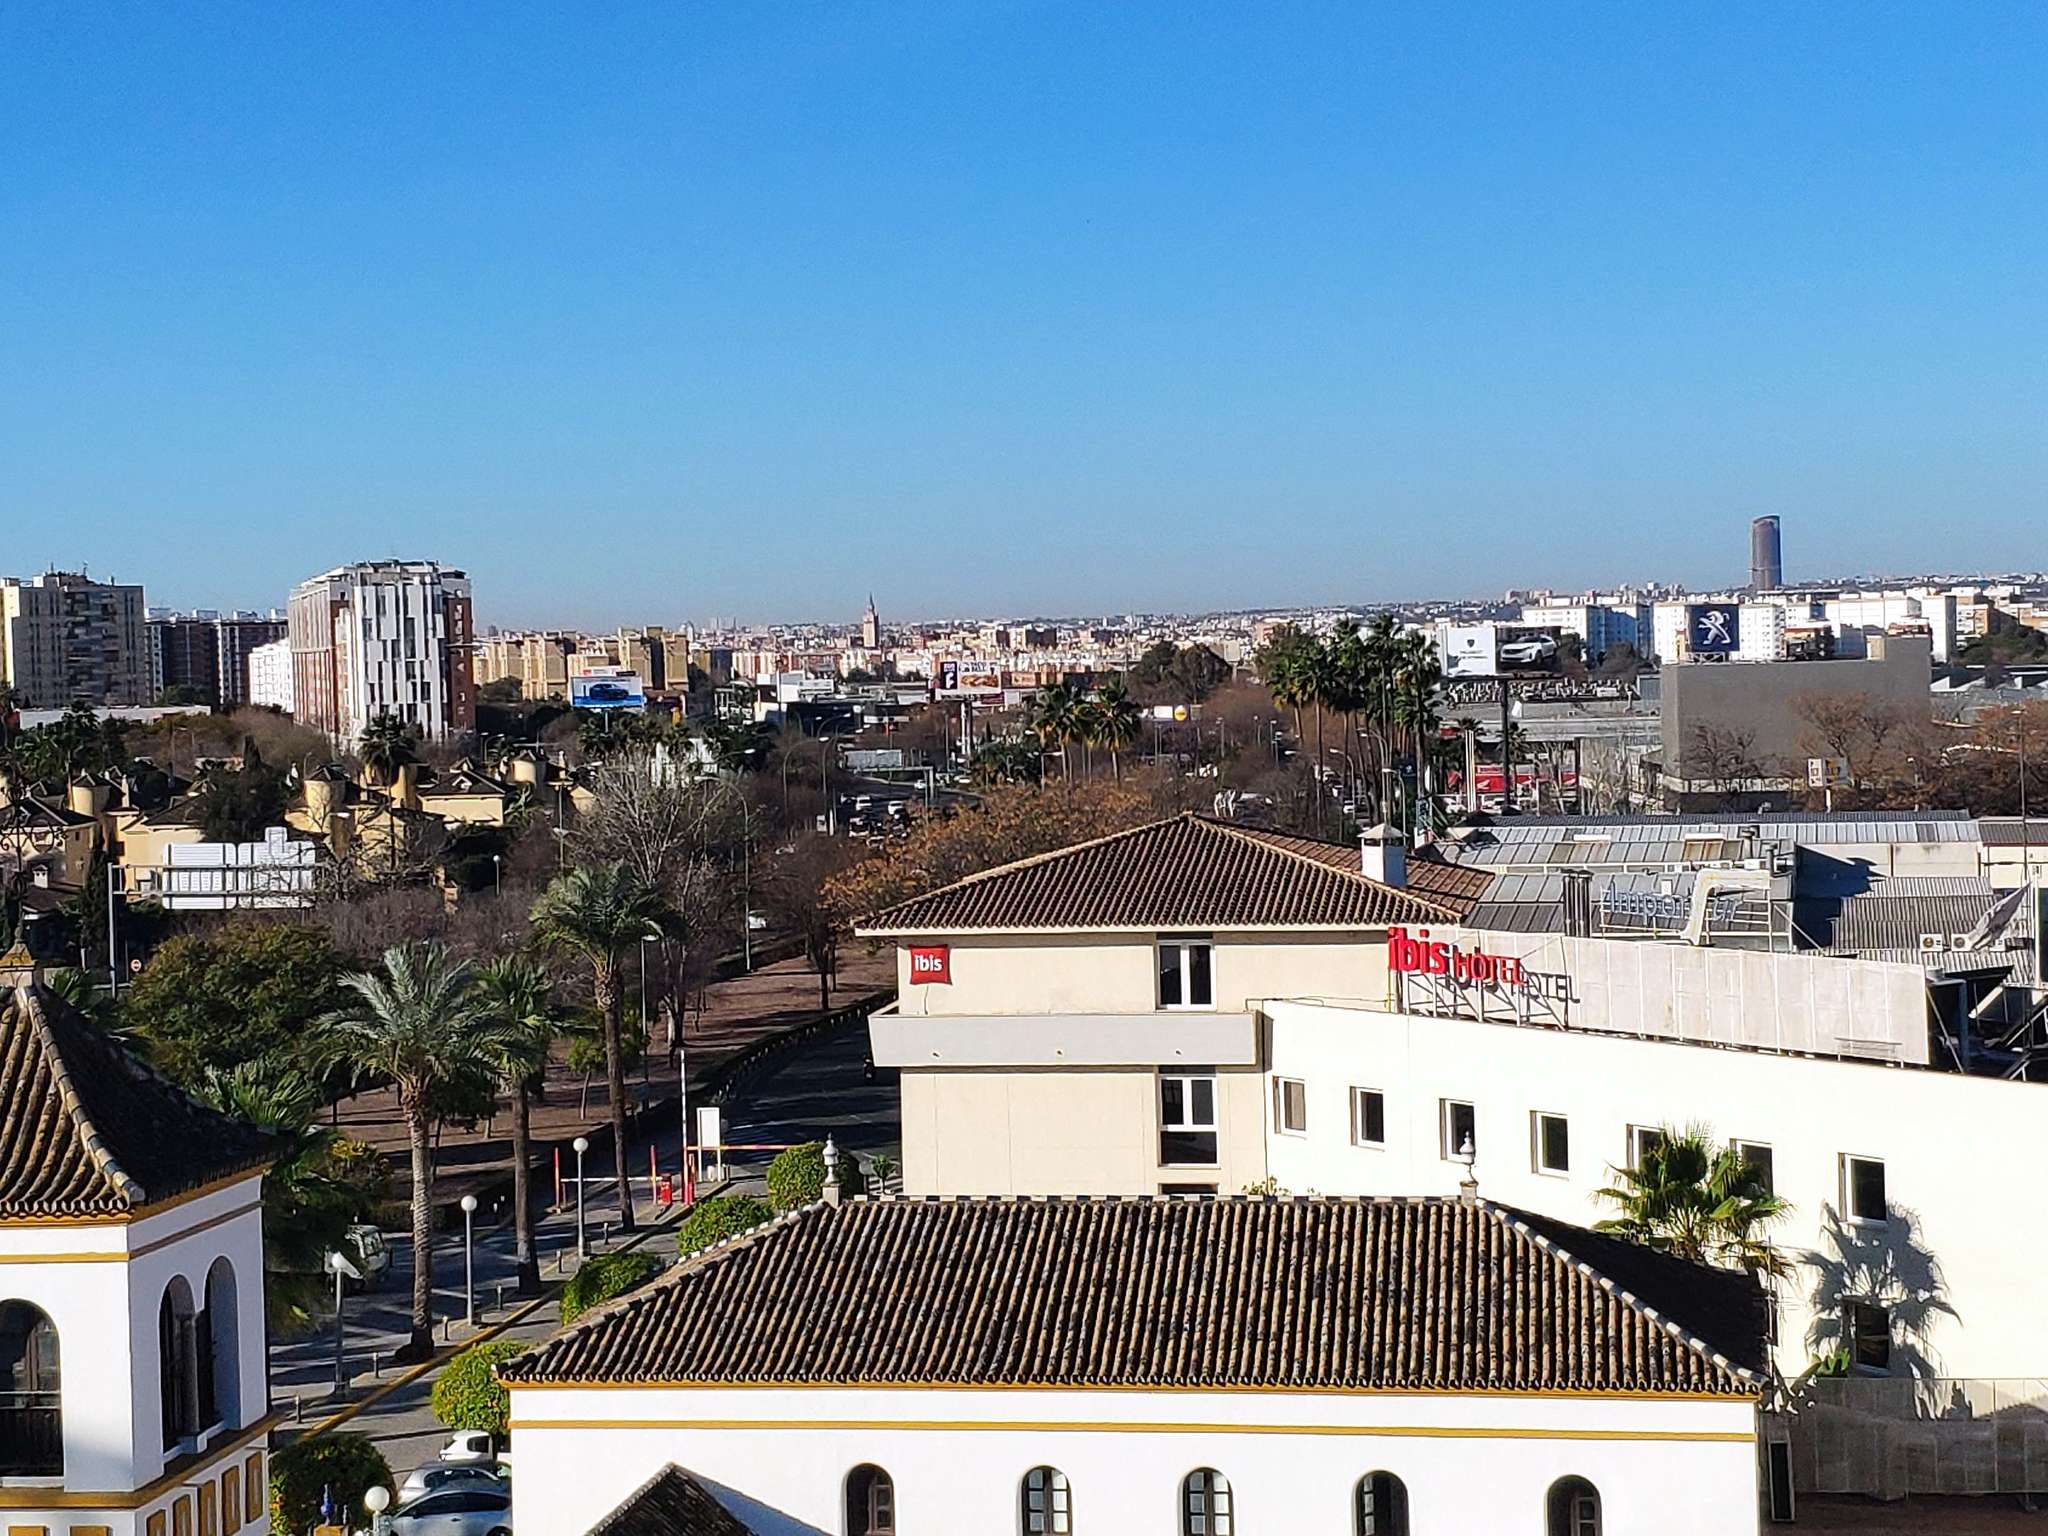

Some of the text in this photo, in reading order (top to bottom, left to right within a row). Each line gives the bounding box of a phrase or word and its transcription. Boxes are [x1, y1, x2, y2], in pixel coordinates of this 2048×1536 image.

[914, 953, 943, 972] ibis
[1387, 926, 1528, 987] ibis HOTEL
